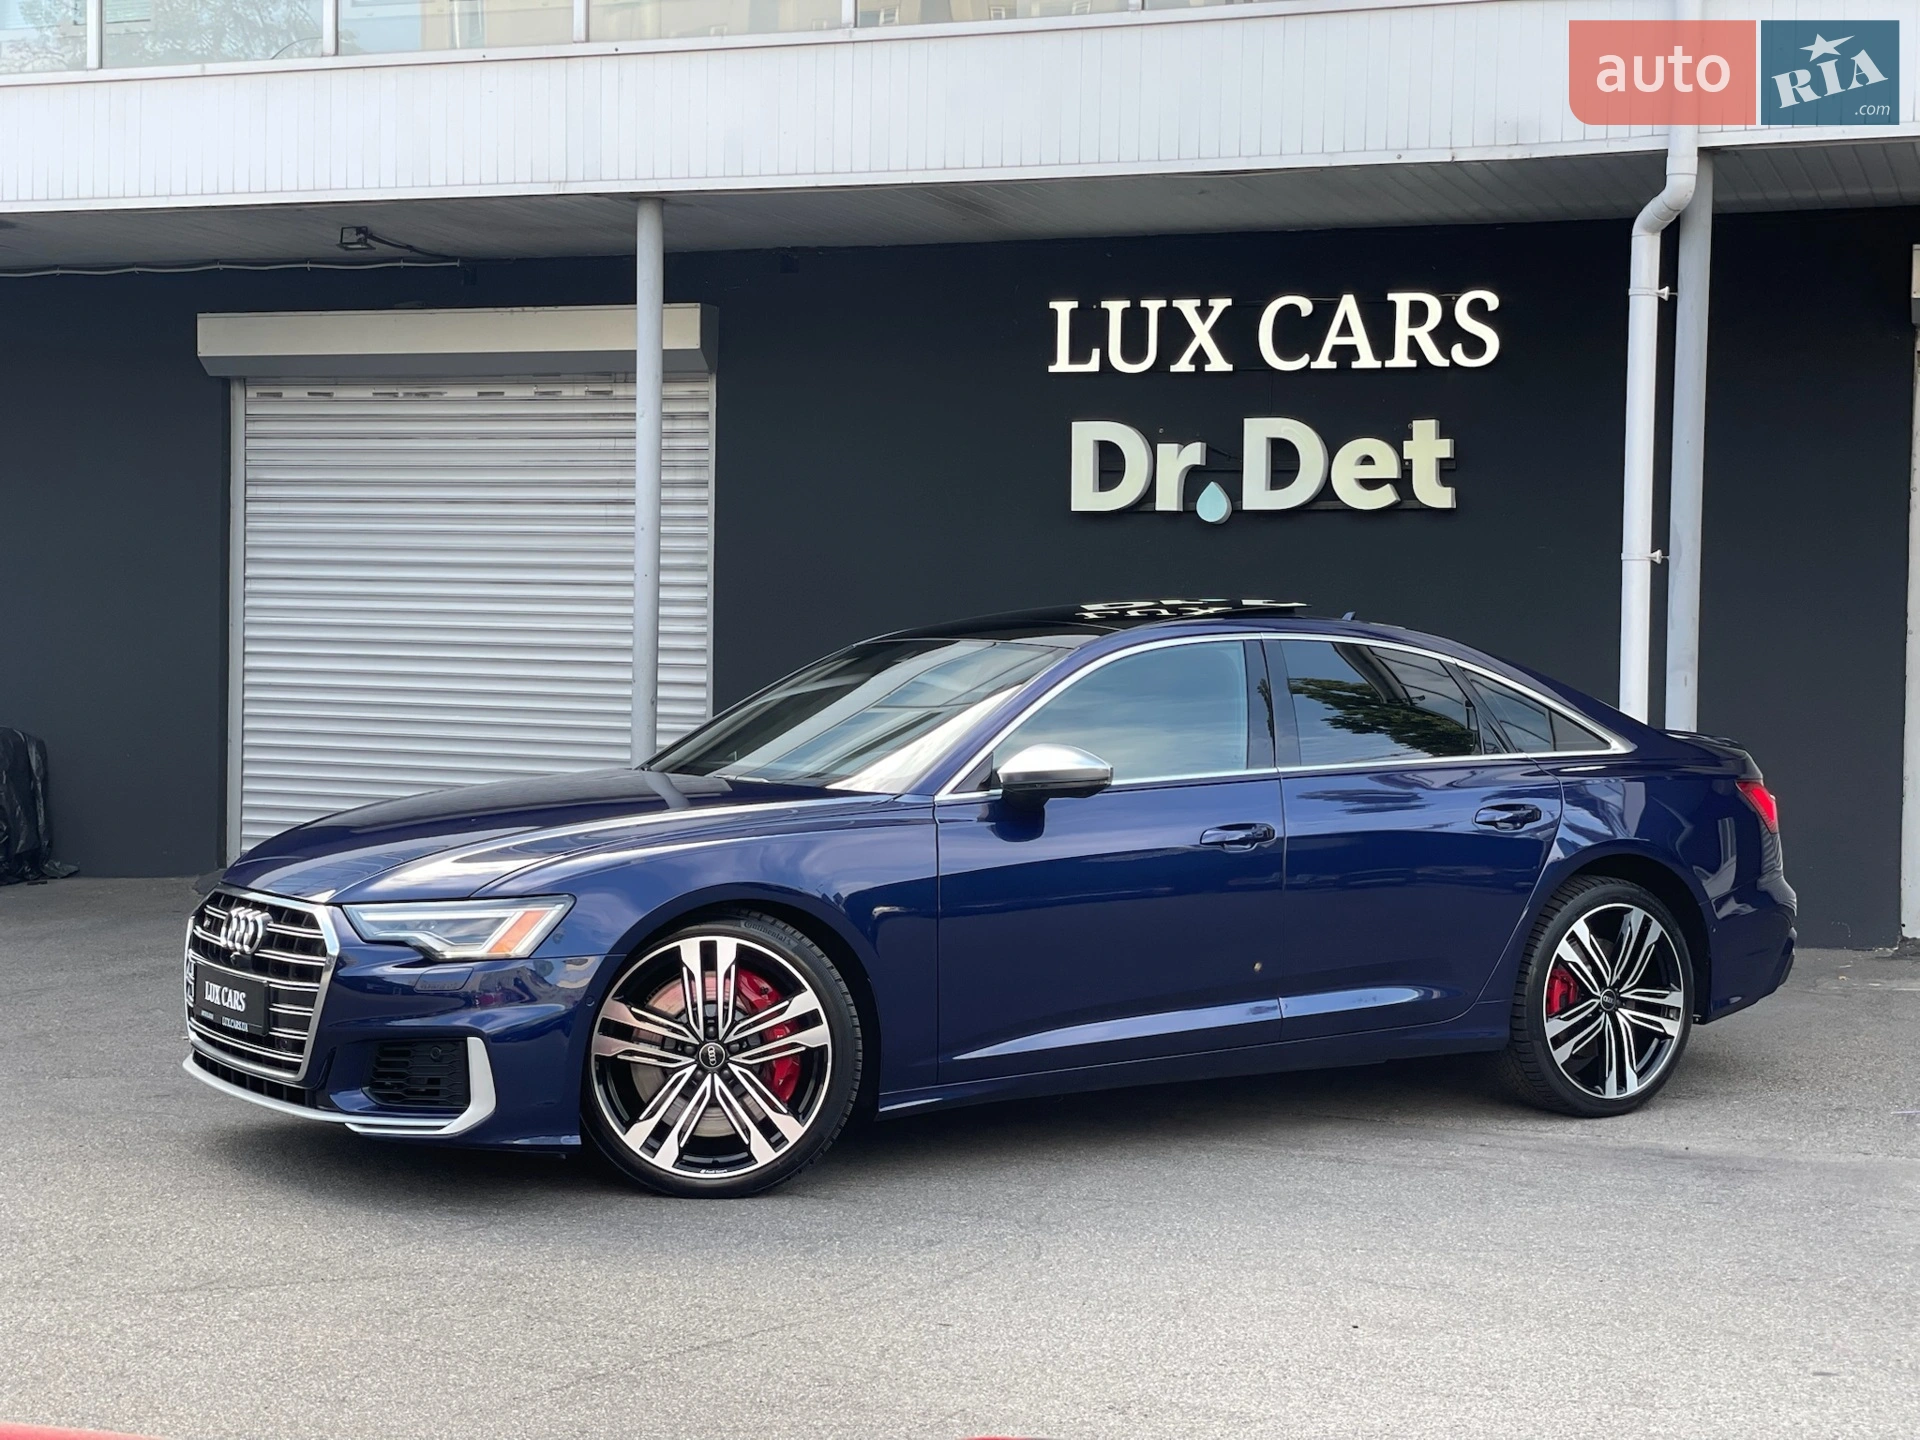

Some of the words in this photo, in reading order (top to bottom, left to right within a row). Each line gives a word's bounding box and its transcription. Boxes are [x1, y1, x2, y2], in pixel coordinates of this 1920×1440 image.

[1048, 298, 1233, 373] LUX
[1257, 289, 1500, 371] CARS
[204, 981, 221, 1005] LUX
[221, 986, 246, 1012] CARS
